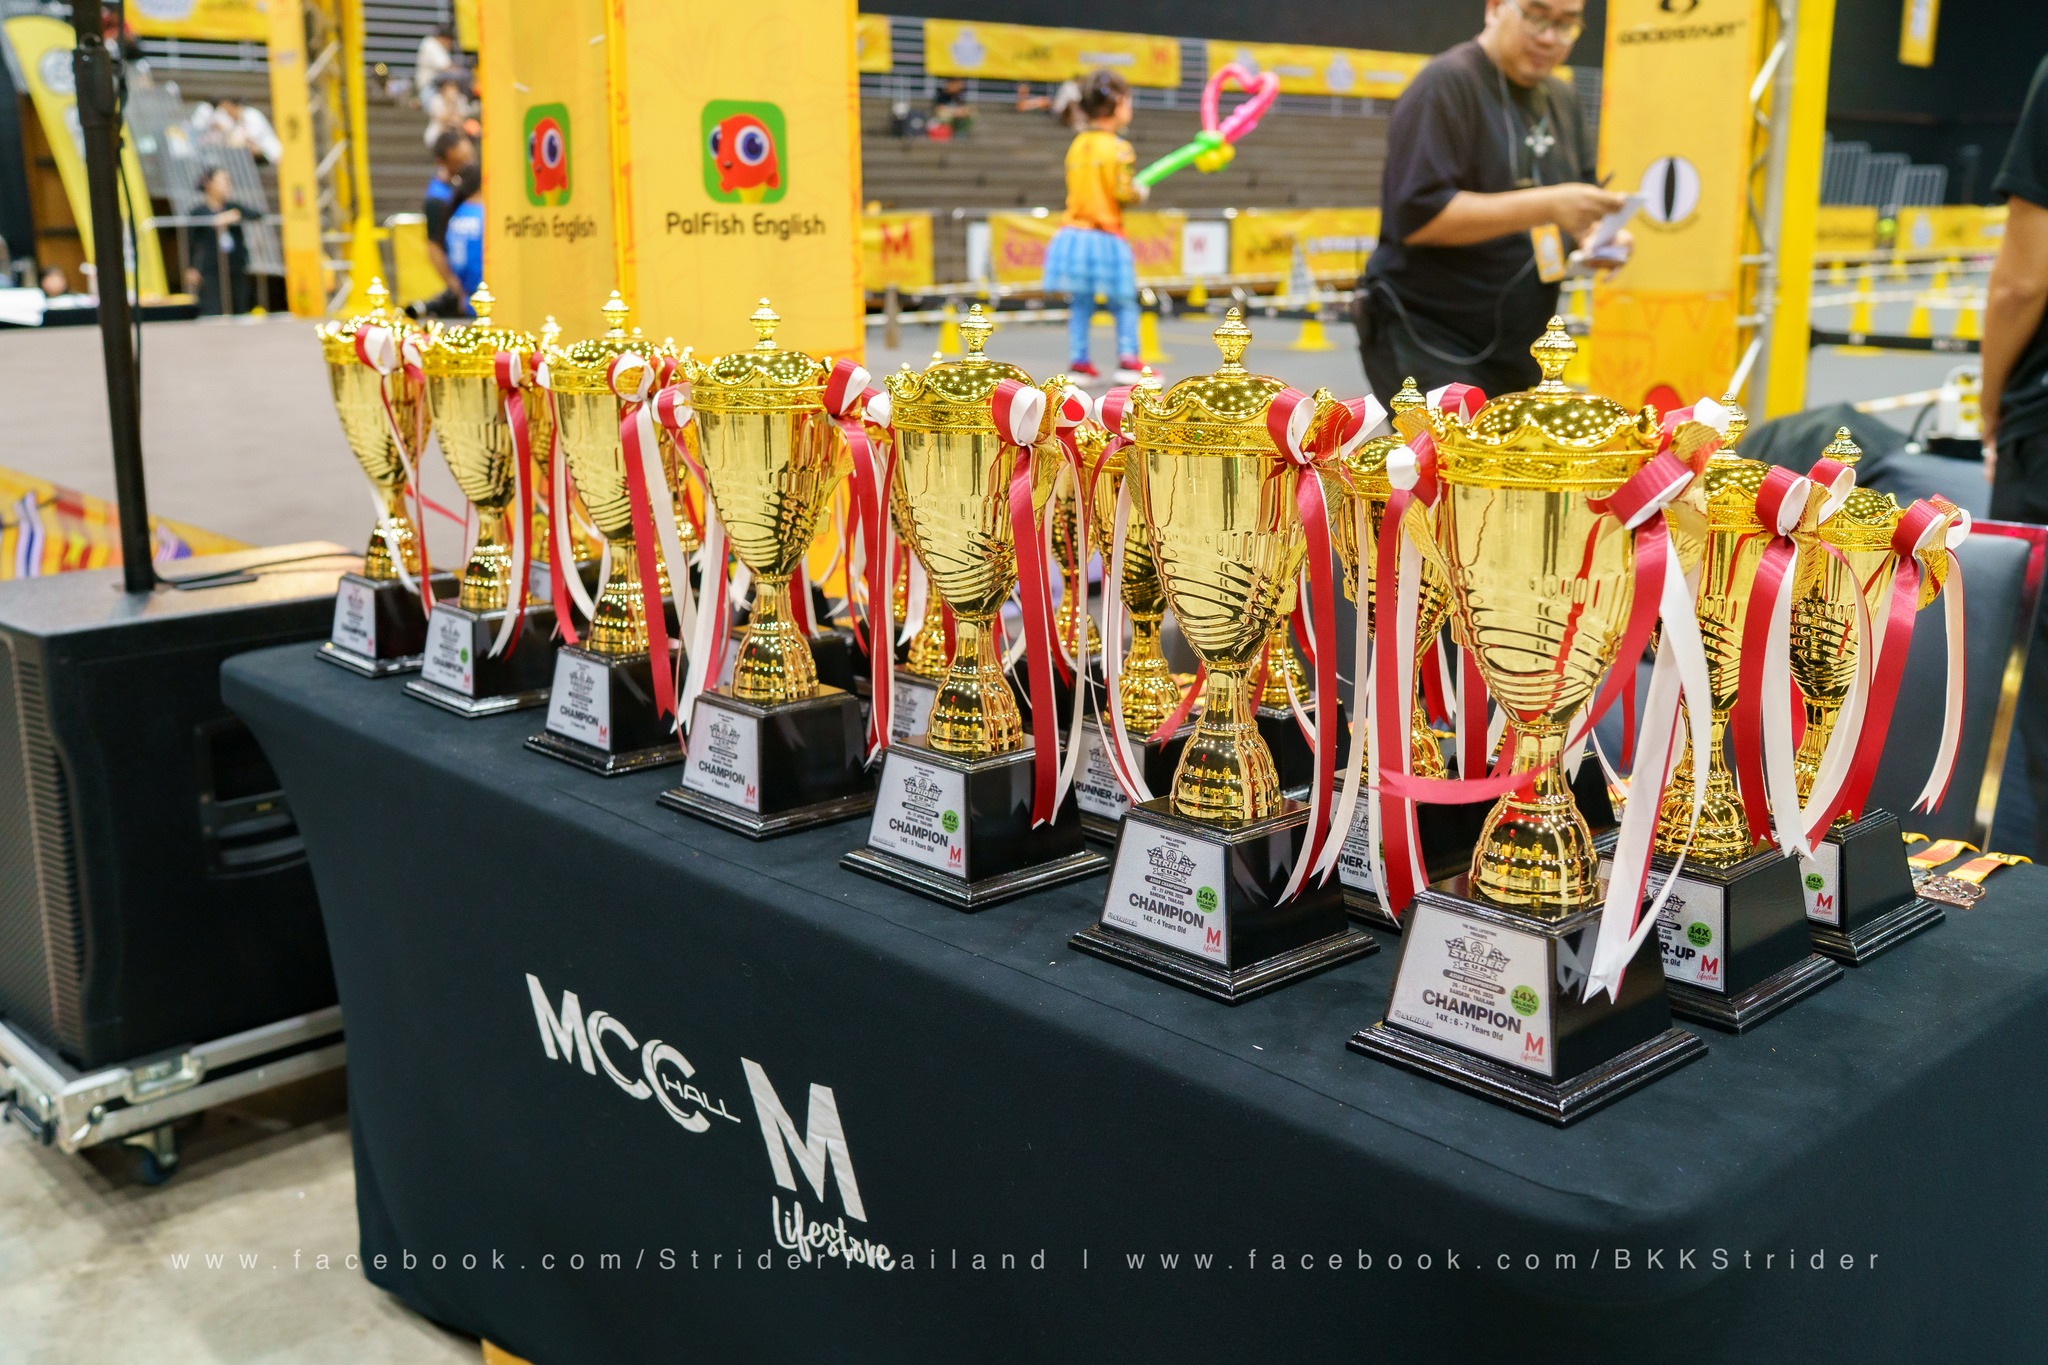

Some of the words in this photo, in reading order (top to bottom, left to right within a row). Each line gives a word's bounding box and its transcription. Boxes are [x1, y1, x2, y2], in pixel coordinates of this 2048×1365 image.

[504, 215, 547, 239] PalFish
[553, 214, 597, 243] English
[666, 211, 744, 235] PalFish
[754, 211, 826, 241] English
[432, 656, 464, 674] CHAMPION
[560, 704, 599, 727] CHAMPION
[698, 760, 745, 785] CHAMPION
[746, 783, 756, 799] M
[906, 785, 940, 802] STRIDER
[1075, 781, 1128, 804] RUNNER-UP
[943, 813, 957, 824] 14X
[889, 818, 948, 847] CHAMPION
[949, 845, 961, 863] M
[1150, 856, 1192, 875] STRIDER
[1198, 890, 1215, 902] 14X
[1817, 892, 1833, 909] M
[1129, 892, 1204, 929] CHAMPION
[1162, 919, 1176, 931] Years
[1177, 926, 1186, 934] Old
[1690, 926, 1709, 937] 14X
[1206, 927, 1221, 947] M
[1449, 948, 1504, 972] STRIDER
[1463, 962, 1487, 972] CUP
[1670, 957, 1681, 967] Old
[1701, 954, 1718, 975] M
[1468, 986, 1480, 995] APRIL
[1513, 990, 1536, 1004] 14X
[1473, 995, 1495, 1006] THAILAND
[1511, 998, 1537, 1011] BALANCE
[1422, 989, 1521, 1034] CHAMPION
[1436, 1012, 1448, 1023] 14X
[1471, 1024, 1490, 1036] Years
[1492, 1031, 1504, 1041] Old
[525, 972, 711, 1133] MCC
[1525, 1031, 1544, 1056] M
[662, 1073, 741, 1123] HALL
[740, 1056, 867, 1223] M
